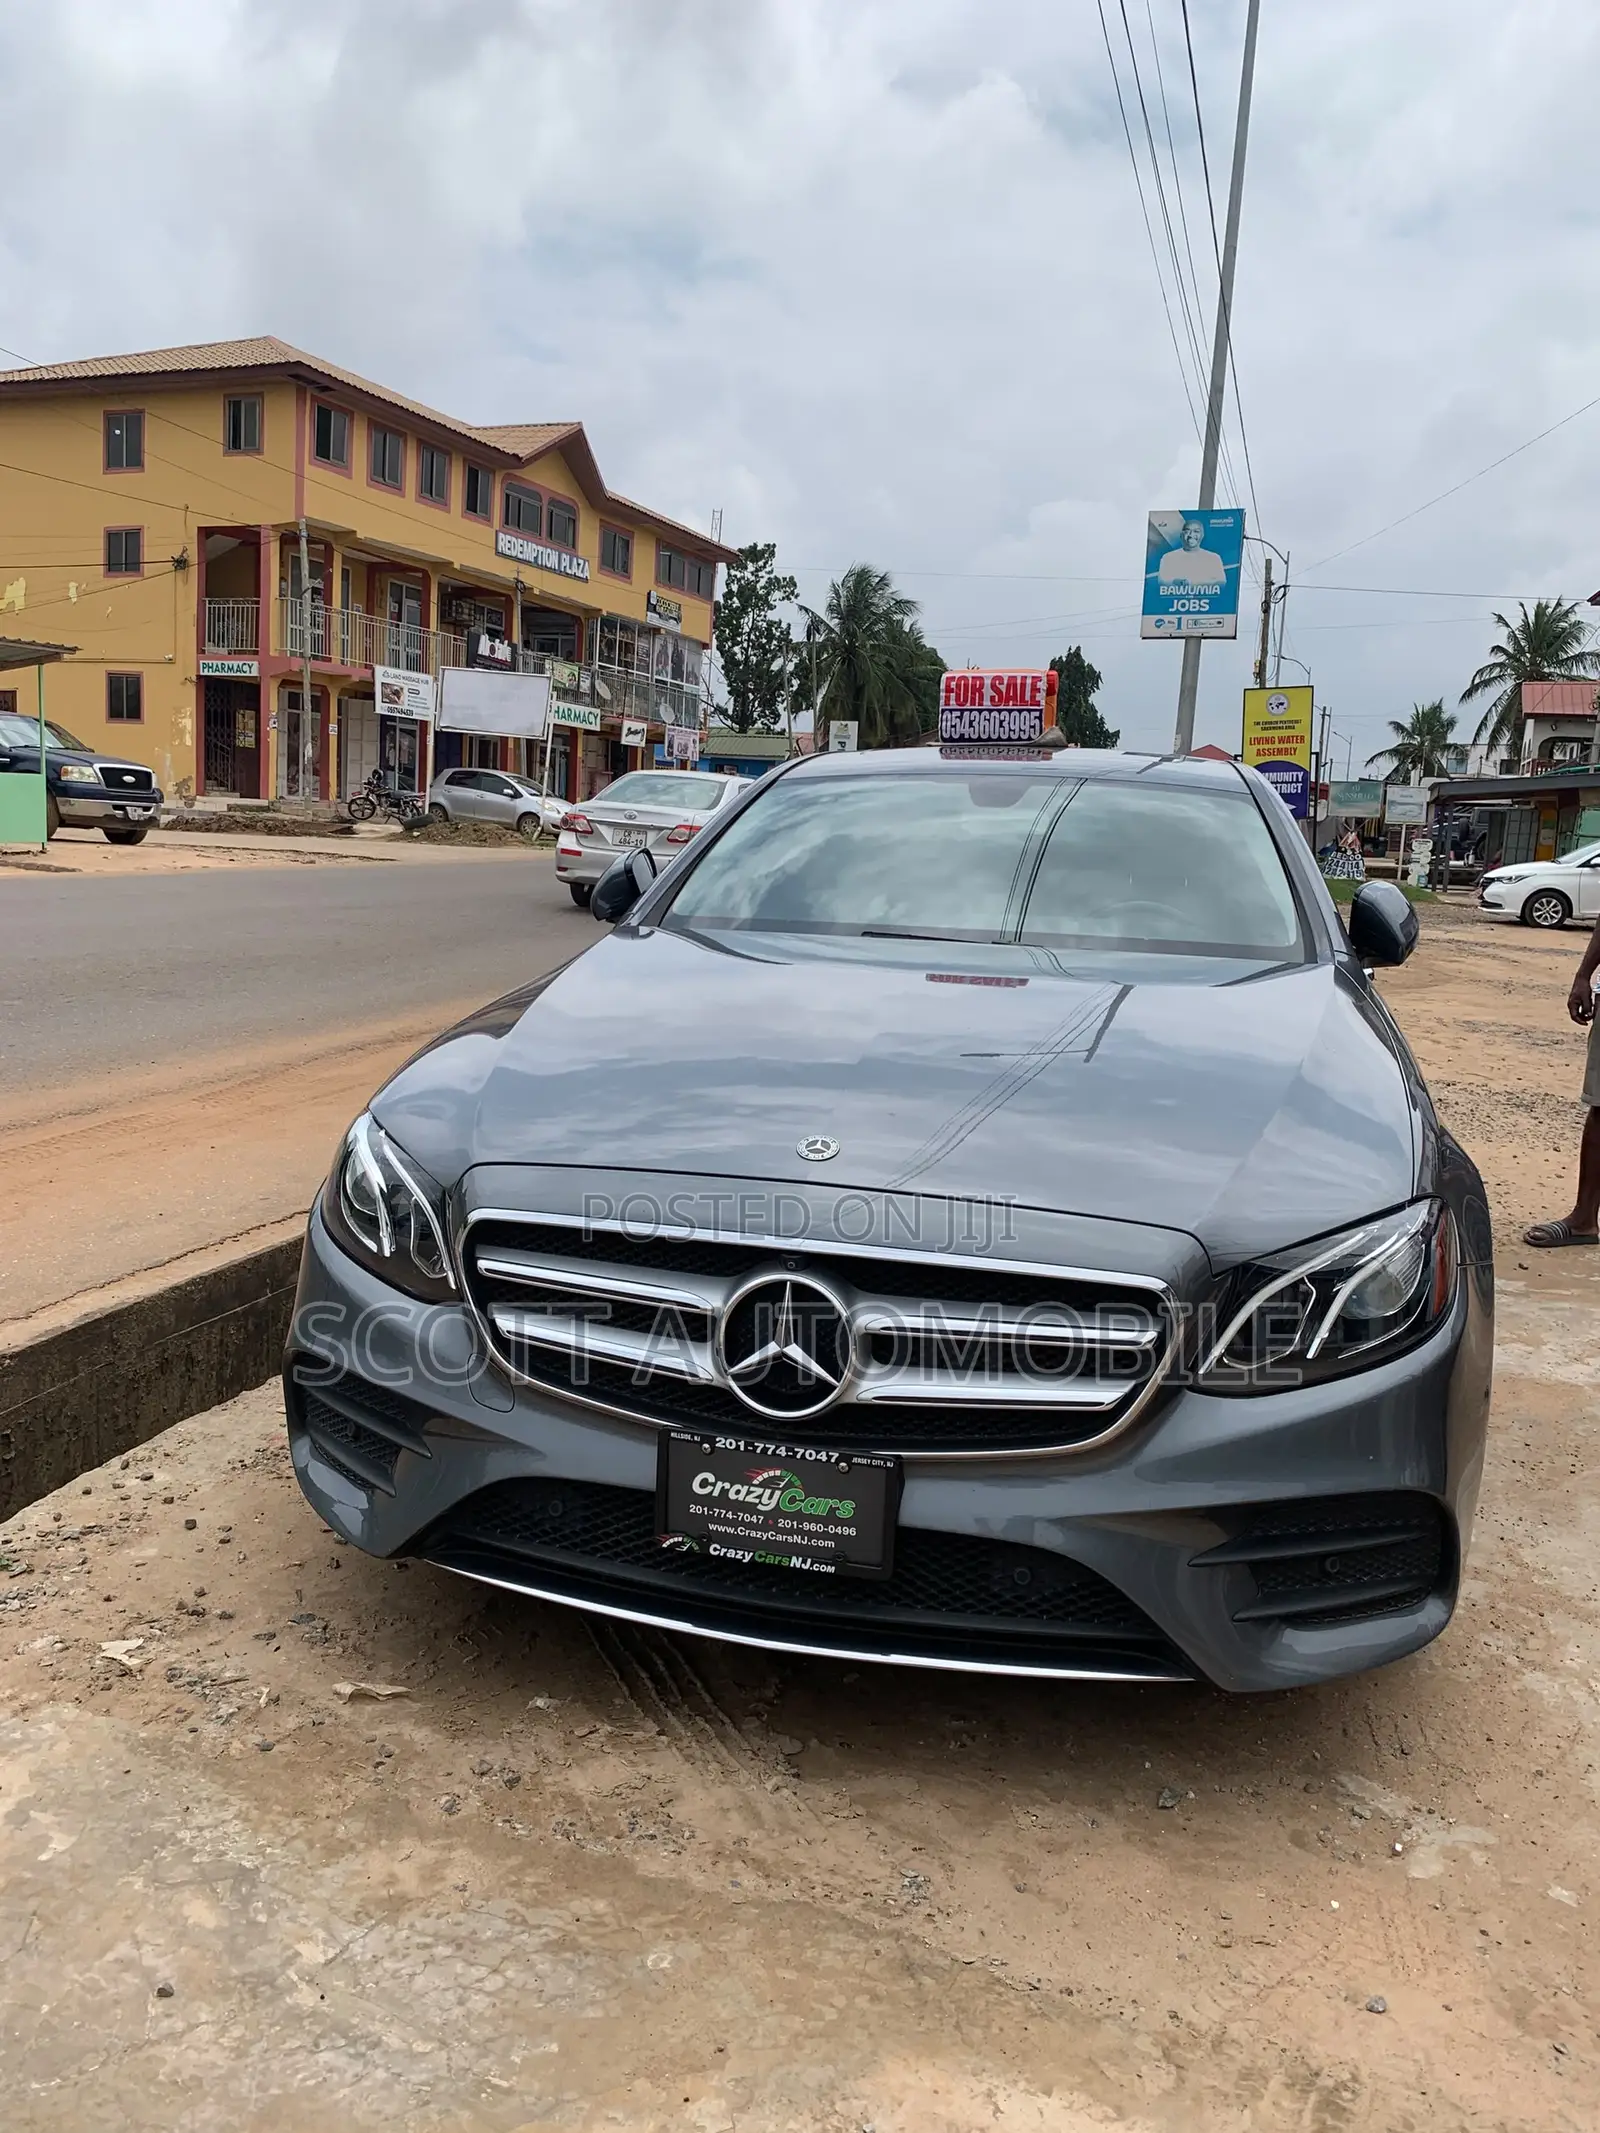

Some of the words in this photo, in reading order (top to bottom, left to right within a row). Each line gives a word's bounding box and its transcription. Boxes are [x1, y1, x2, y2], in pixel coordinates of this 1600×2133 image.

[497, 532, 559, 570] REDEMPTION
[561, 552, 590, 580] PLAZA
[1160, 585, 1220, 595] BAWUMIA
[1169, 599, 1210, 612] JOBS
[202, 662, 254, 674] PHARMACY
[944, 675, 985, 707] FOR
[990, 675, 1042, 707] SALE
[554, 706, 599, 726] HARMACY
[941, 710, 1040, 739] 0543603995
[1249, 736, 1275, 746] LIVING
[1278, 735, 1305, 744] WATER
[1256, 747, 1297, 757] ASSEMBLY
[1262, 772, 1303, 782] MMUNITY
[670, 1432, 693, 1441] HILLSIDE,
[715, 1437, 839, 1463] 201-774-7047
[852, 1457, 871, 1465] JERSEY
[692, 1472, 856, 1518] CrazyCars
[689, 1504, 764, 1525] 201-774-7047
[777, 1519, 857, 1536] 201-960-0496
[708, 1522, 835, 1548] www.CrazyCarsNJ.com
